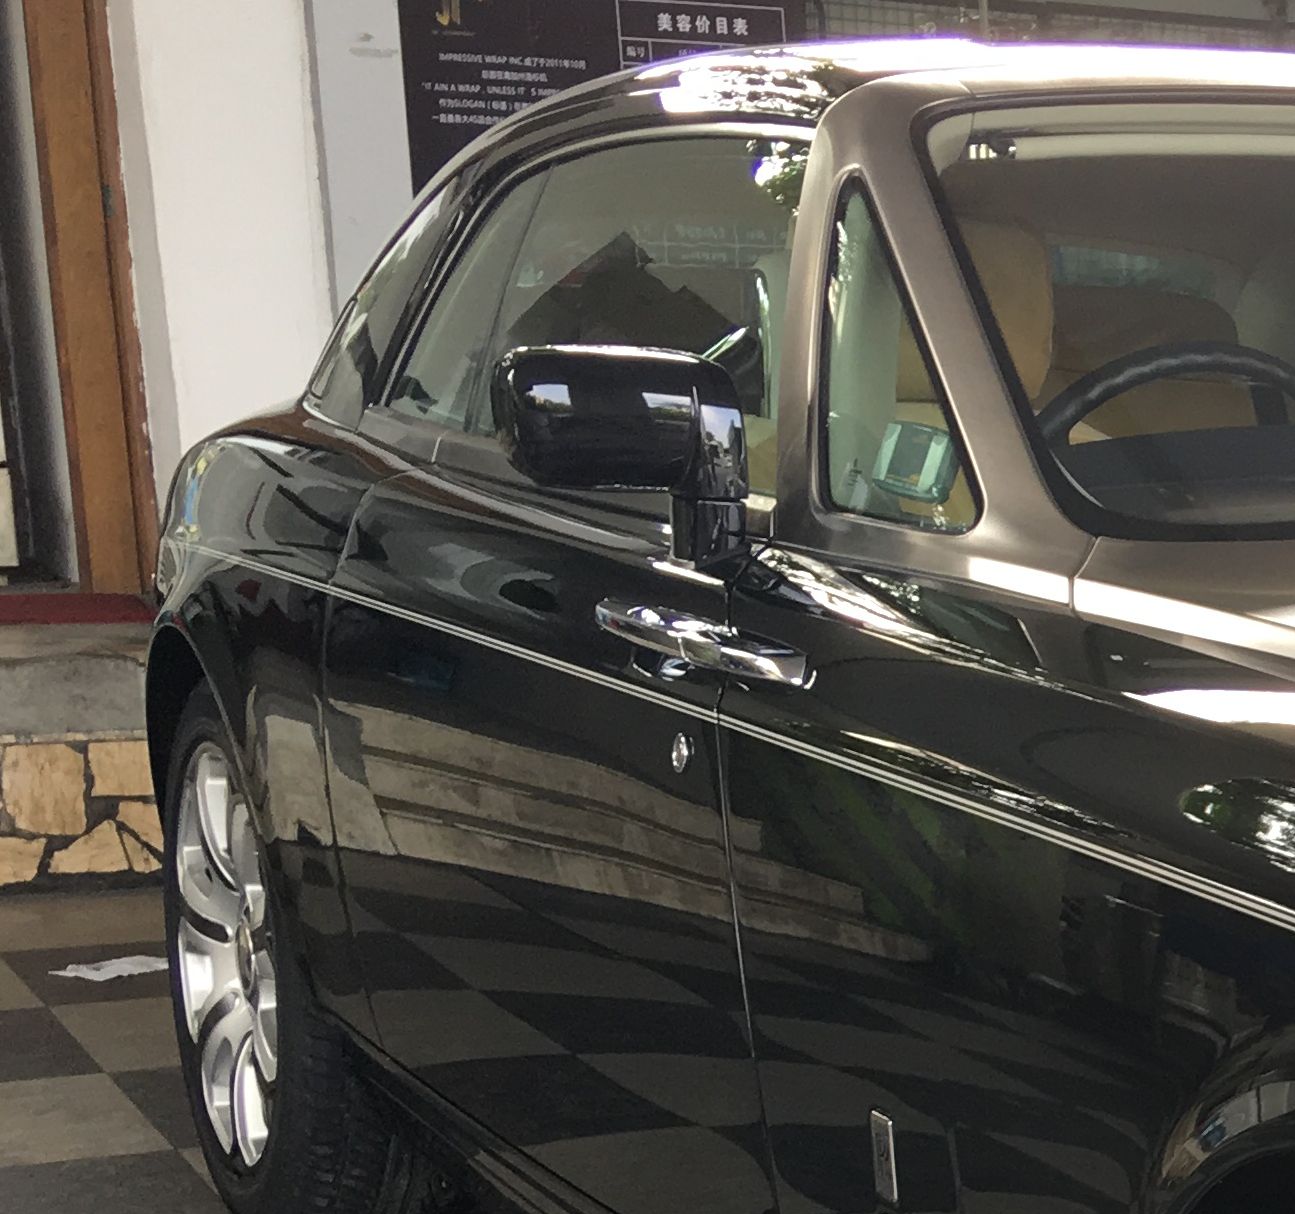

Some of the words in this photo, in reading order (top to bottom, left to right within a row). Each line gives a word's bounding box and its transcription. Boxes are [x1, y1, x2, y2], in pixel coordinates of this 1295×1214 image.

[657, 12, 749, 36] 美容价目表
